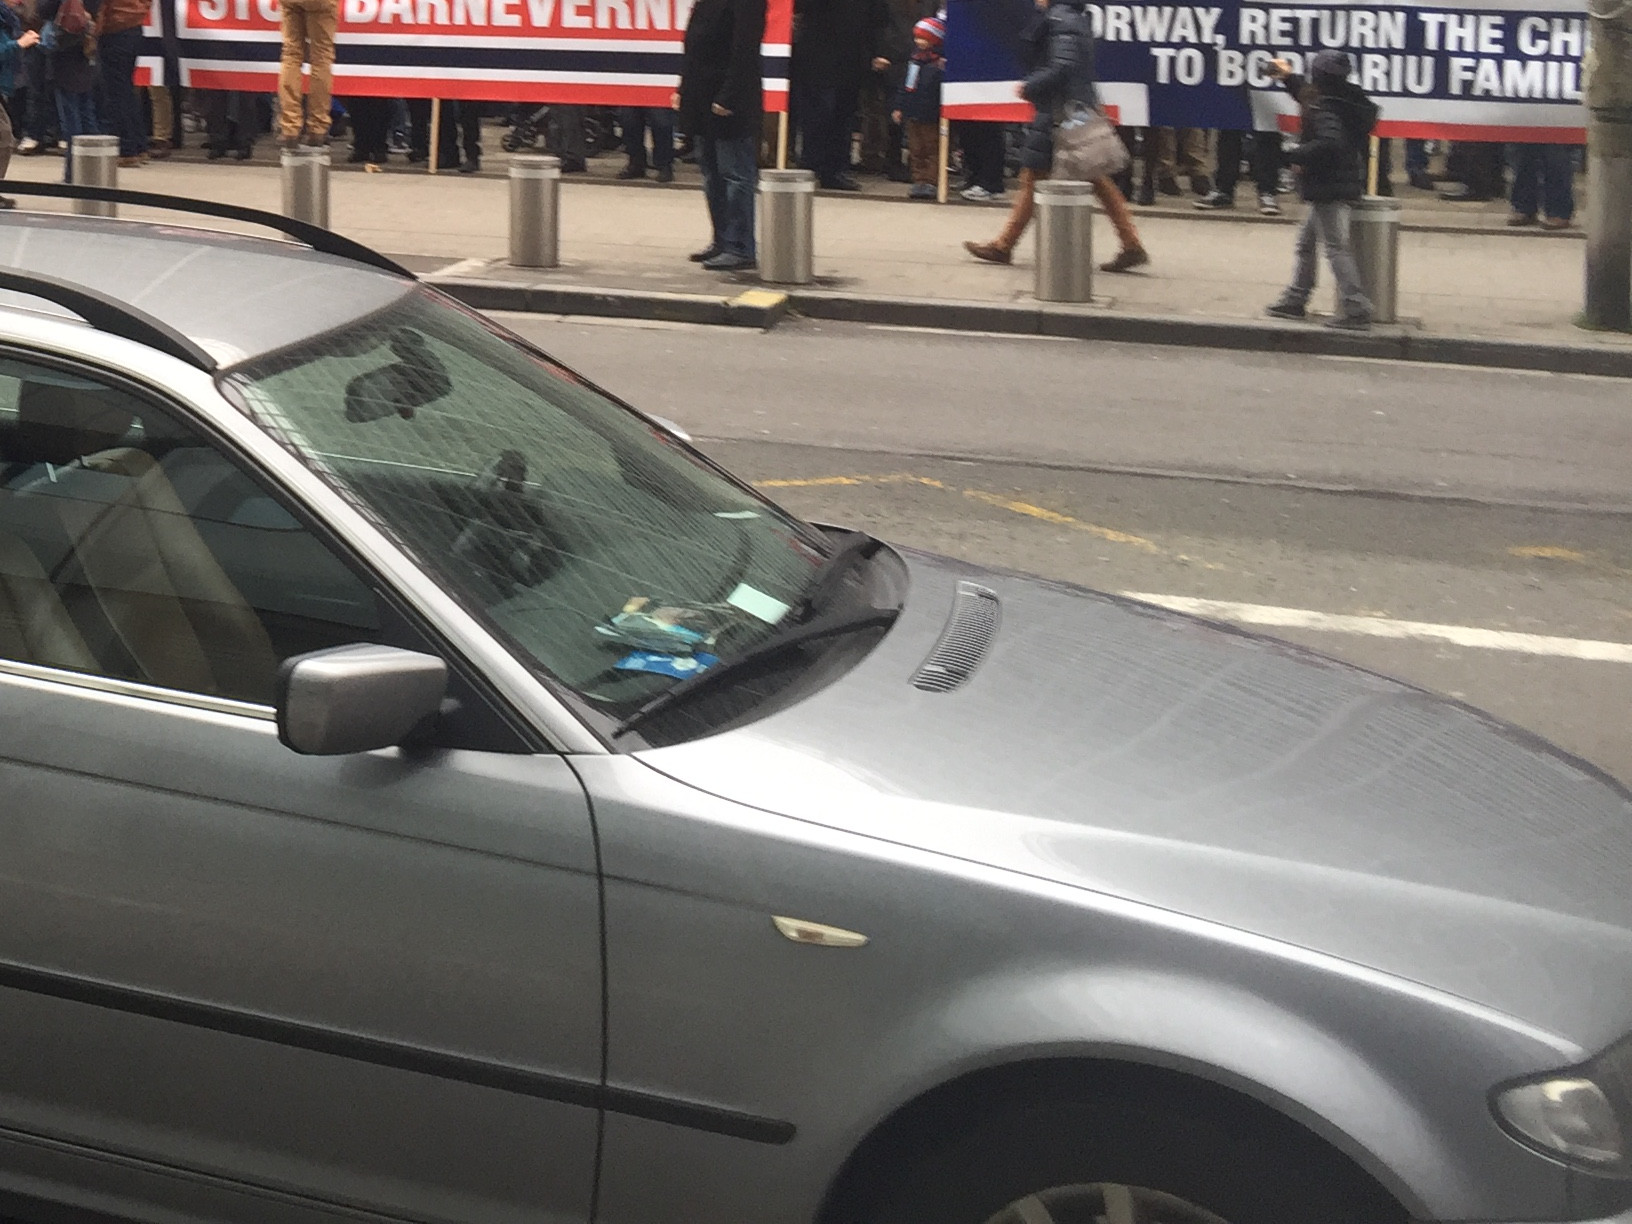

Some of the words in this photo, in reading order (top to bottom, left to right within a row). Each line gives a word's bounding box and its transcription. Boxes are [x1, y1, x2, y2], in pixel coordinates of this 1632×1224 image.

[1084, 3, 1226, 49] ORWAY,
[1239, 7, 1407, 50] RETURN
[1418, 12, 1505, 54] THE
[1150, 47, 1205, 86] TO
[1448, 56, 1584, 101] FAMIL
